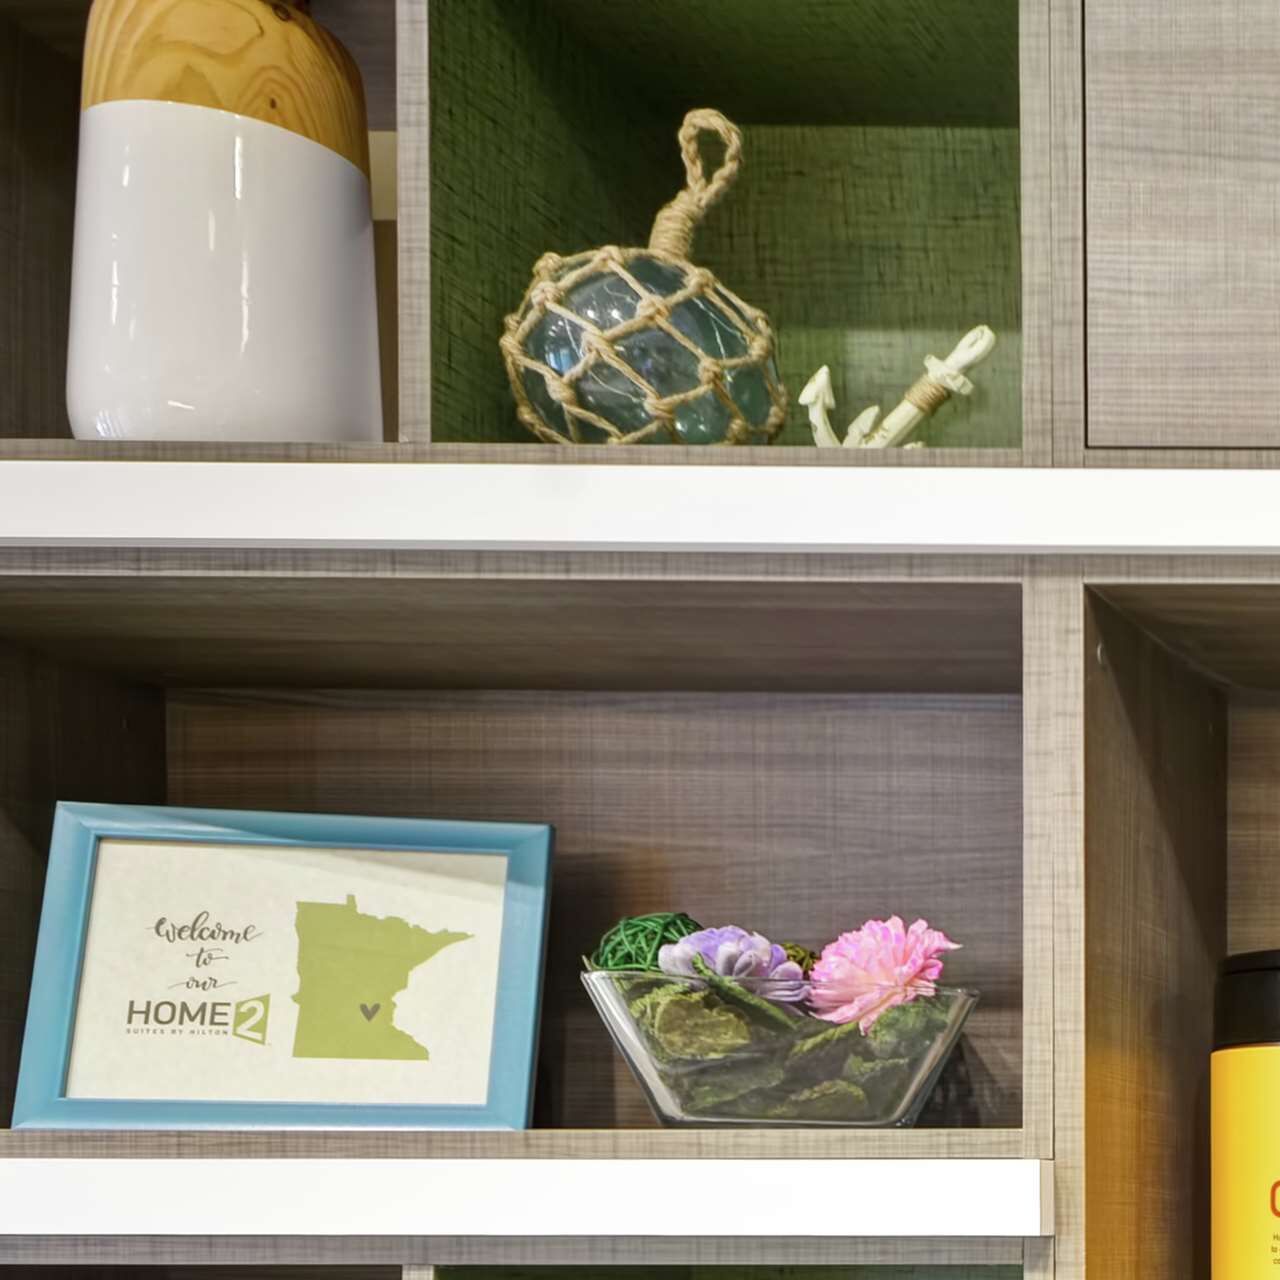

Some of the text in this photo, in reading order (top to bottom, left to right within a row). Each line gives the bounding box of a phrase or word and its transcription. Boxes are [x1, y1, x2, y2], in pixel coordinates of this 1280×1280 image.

[145, 910, 265, 944] welcome
[185, 946, 230, 968] to
[168, 976, 238, 991] our
